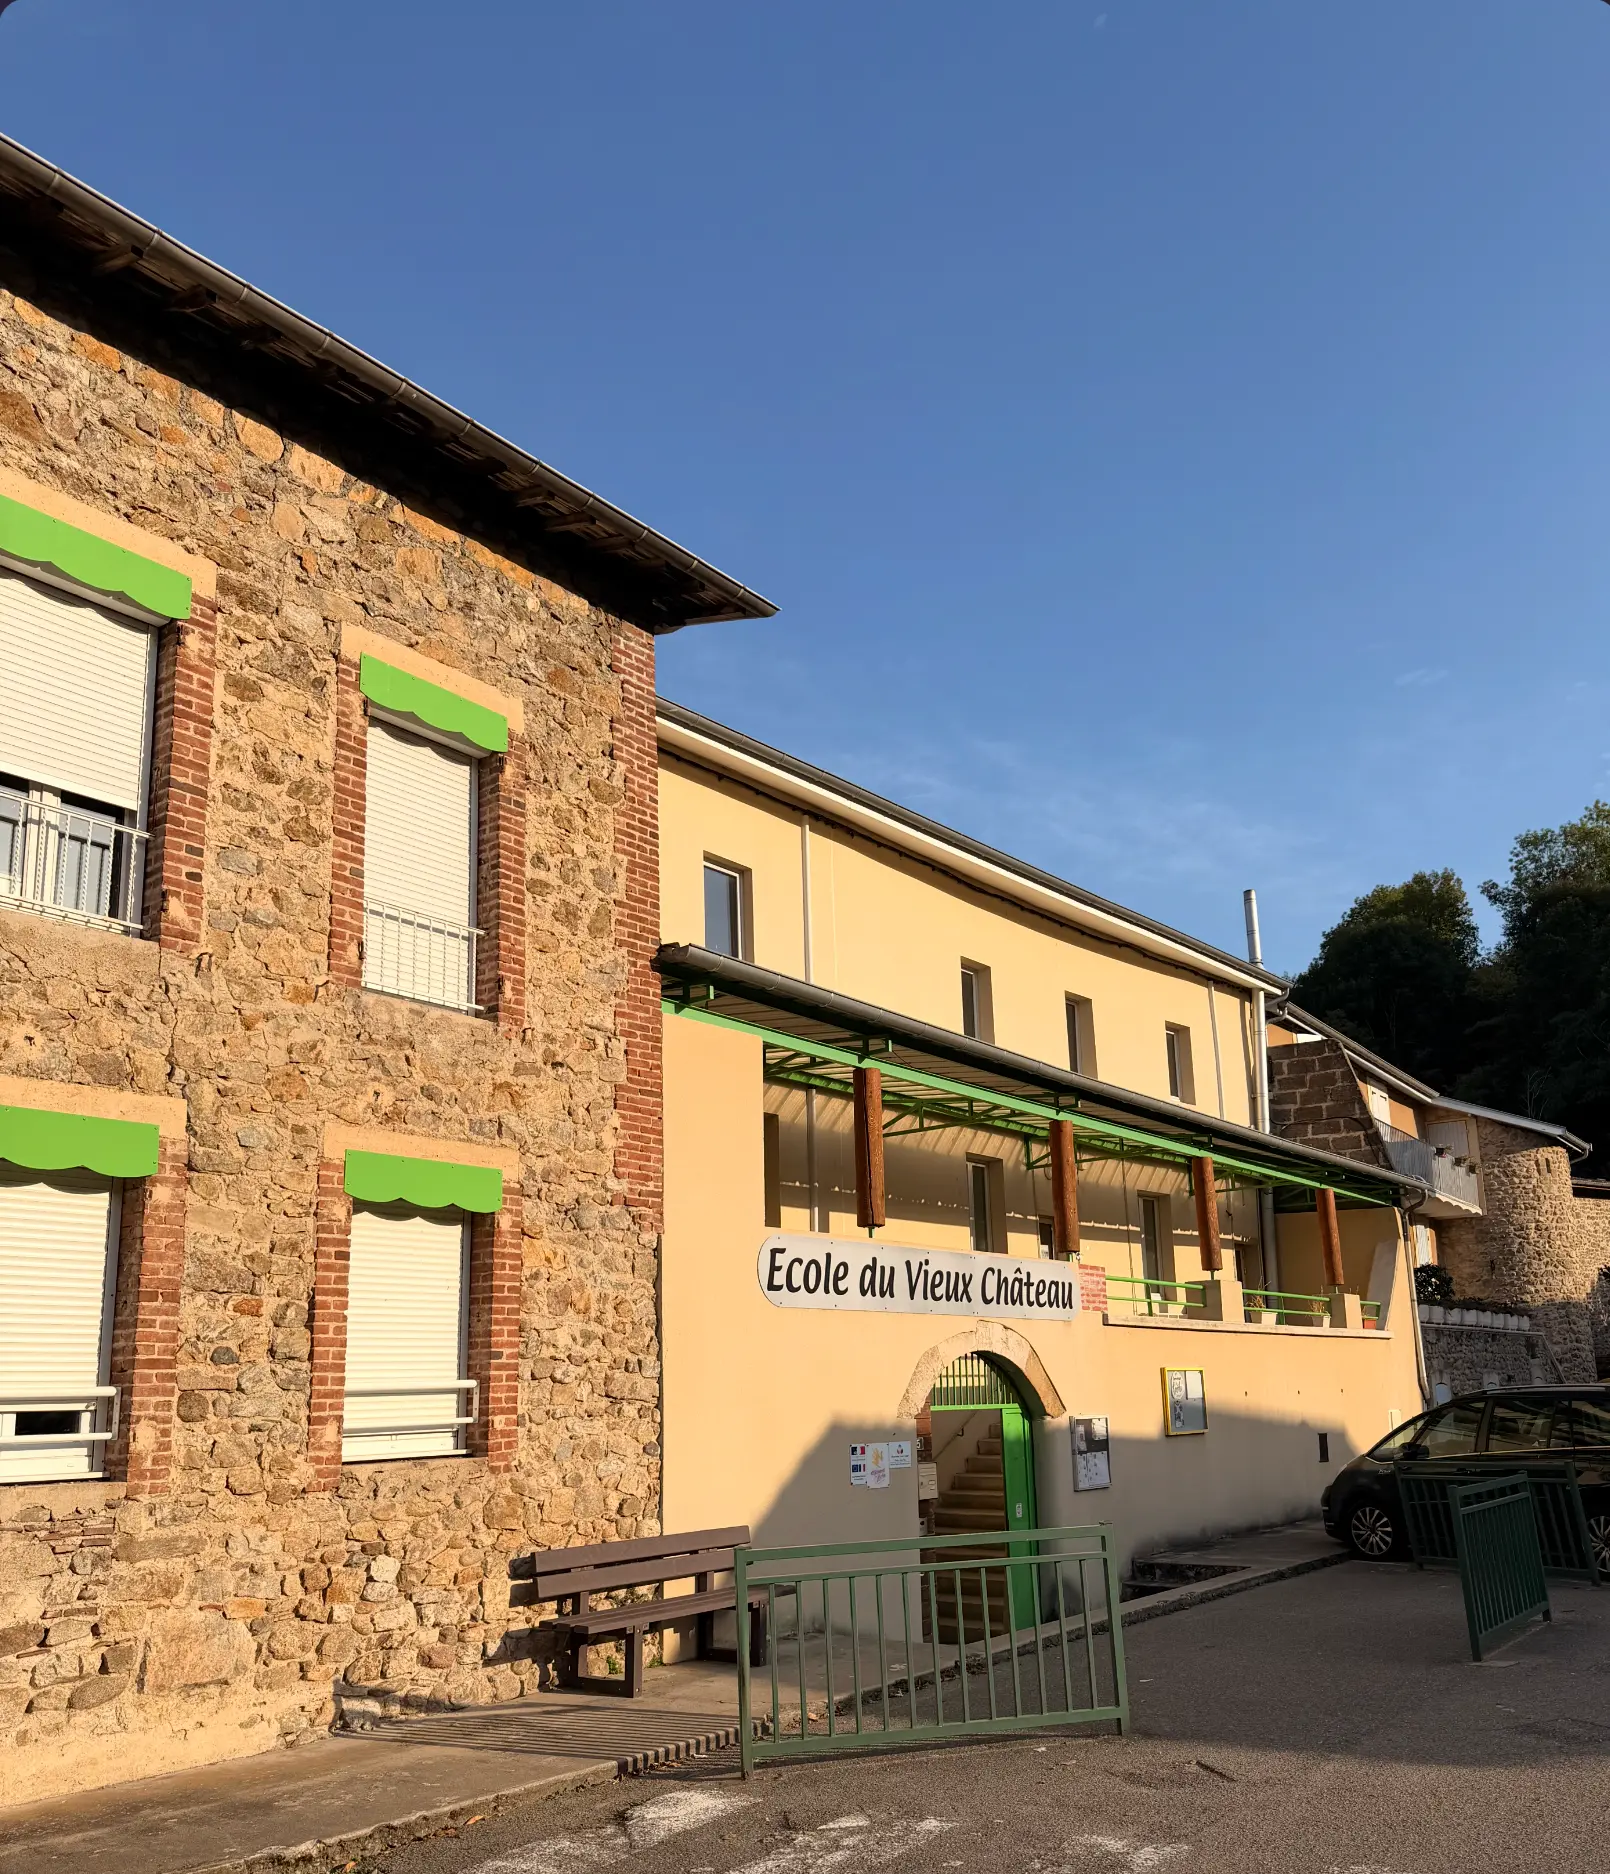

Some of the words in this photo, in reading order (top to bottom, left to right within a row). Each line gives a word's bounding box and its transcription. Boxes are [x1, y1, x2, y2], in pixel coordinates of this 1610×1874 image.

[767, 1248, 848, 1295] Ecole
[860, 1257, 894, 1298] du
[905, 1259, 972, 1303] Vieux
[981, 1267, 1073, 1309] Château
